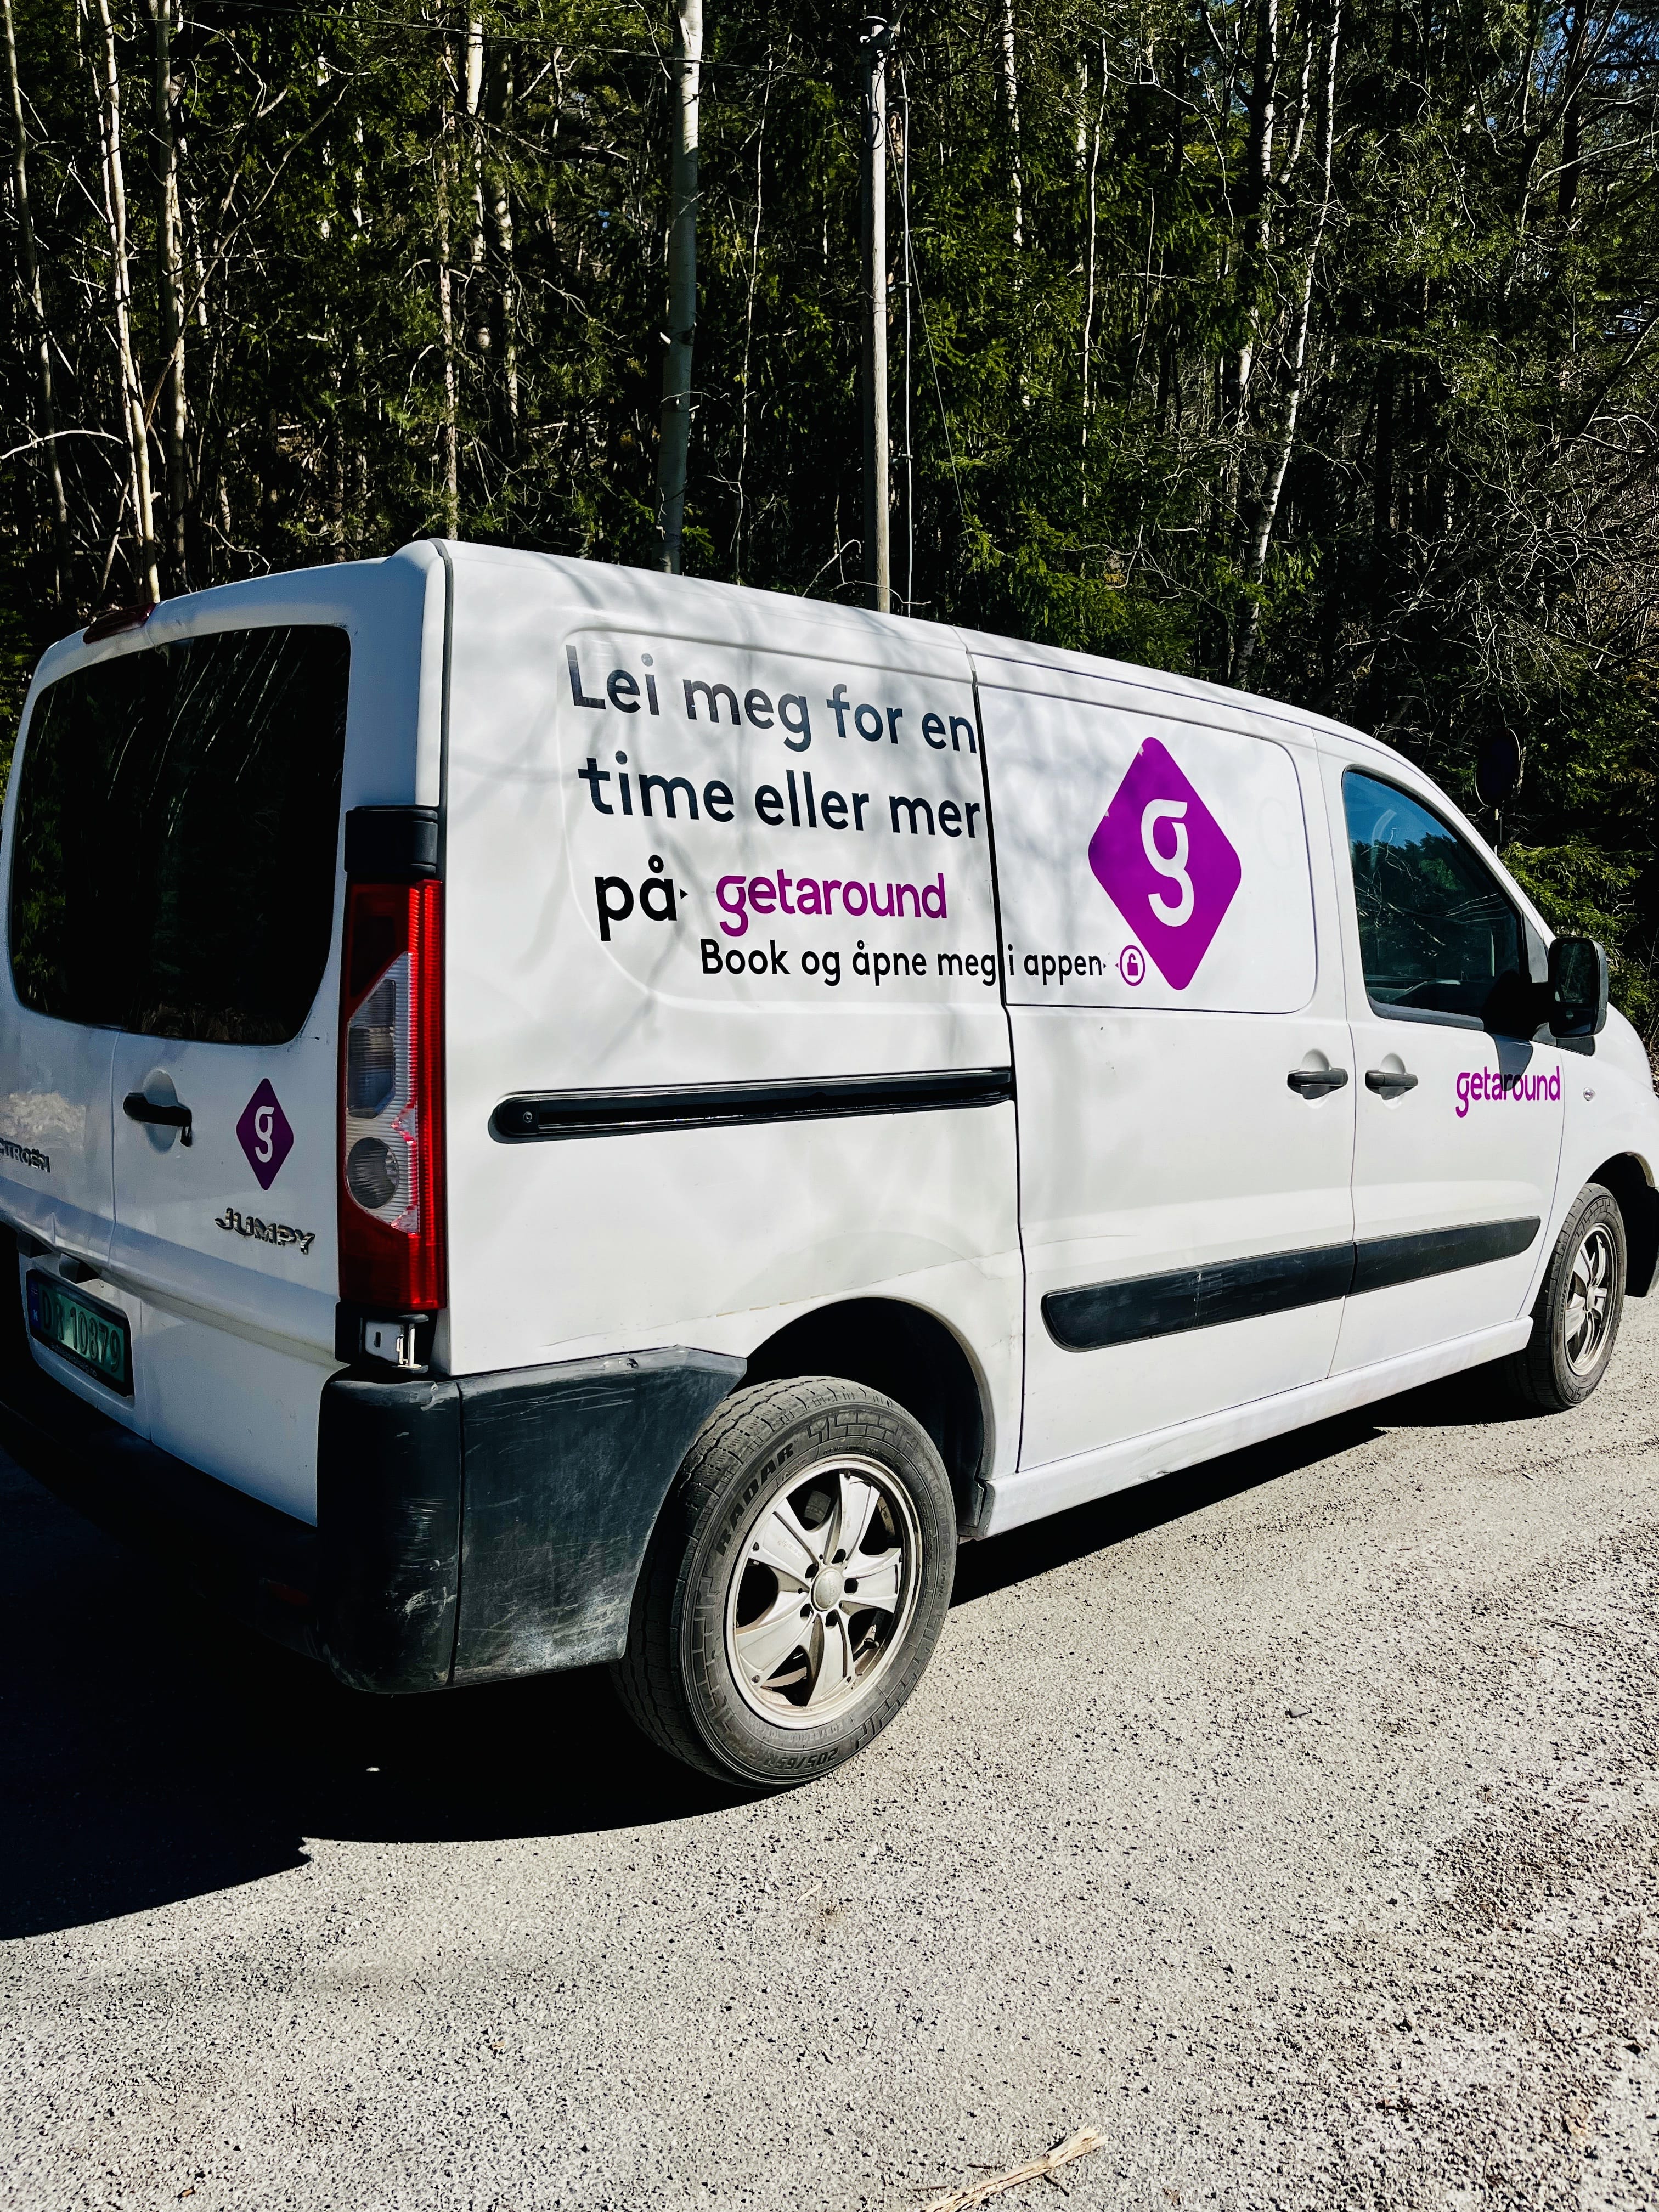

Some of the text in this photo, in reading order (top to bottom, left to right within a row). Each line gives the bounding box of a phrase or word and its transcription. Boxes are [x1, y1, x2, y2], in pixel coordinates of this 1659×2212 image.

[565, 644, 978, 754] Lei meg for en
[578, 751, 981, 839] time eller mer
[594, 854, 948, 941] på getaround
[700, 938, 1102, 987] Book og åpne meg i appen
[1455, 1066, 1561, 1118] getaround
[215, 1207, 316, 1255] JUMPY
[70, 1306, 121, 1373] 10879
[715, 1443, 793, 1557] RADAR
